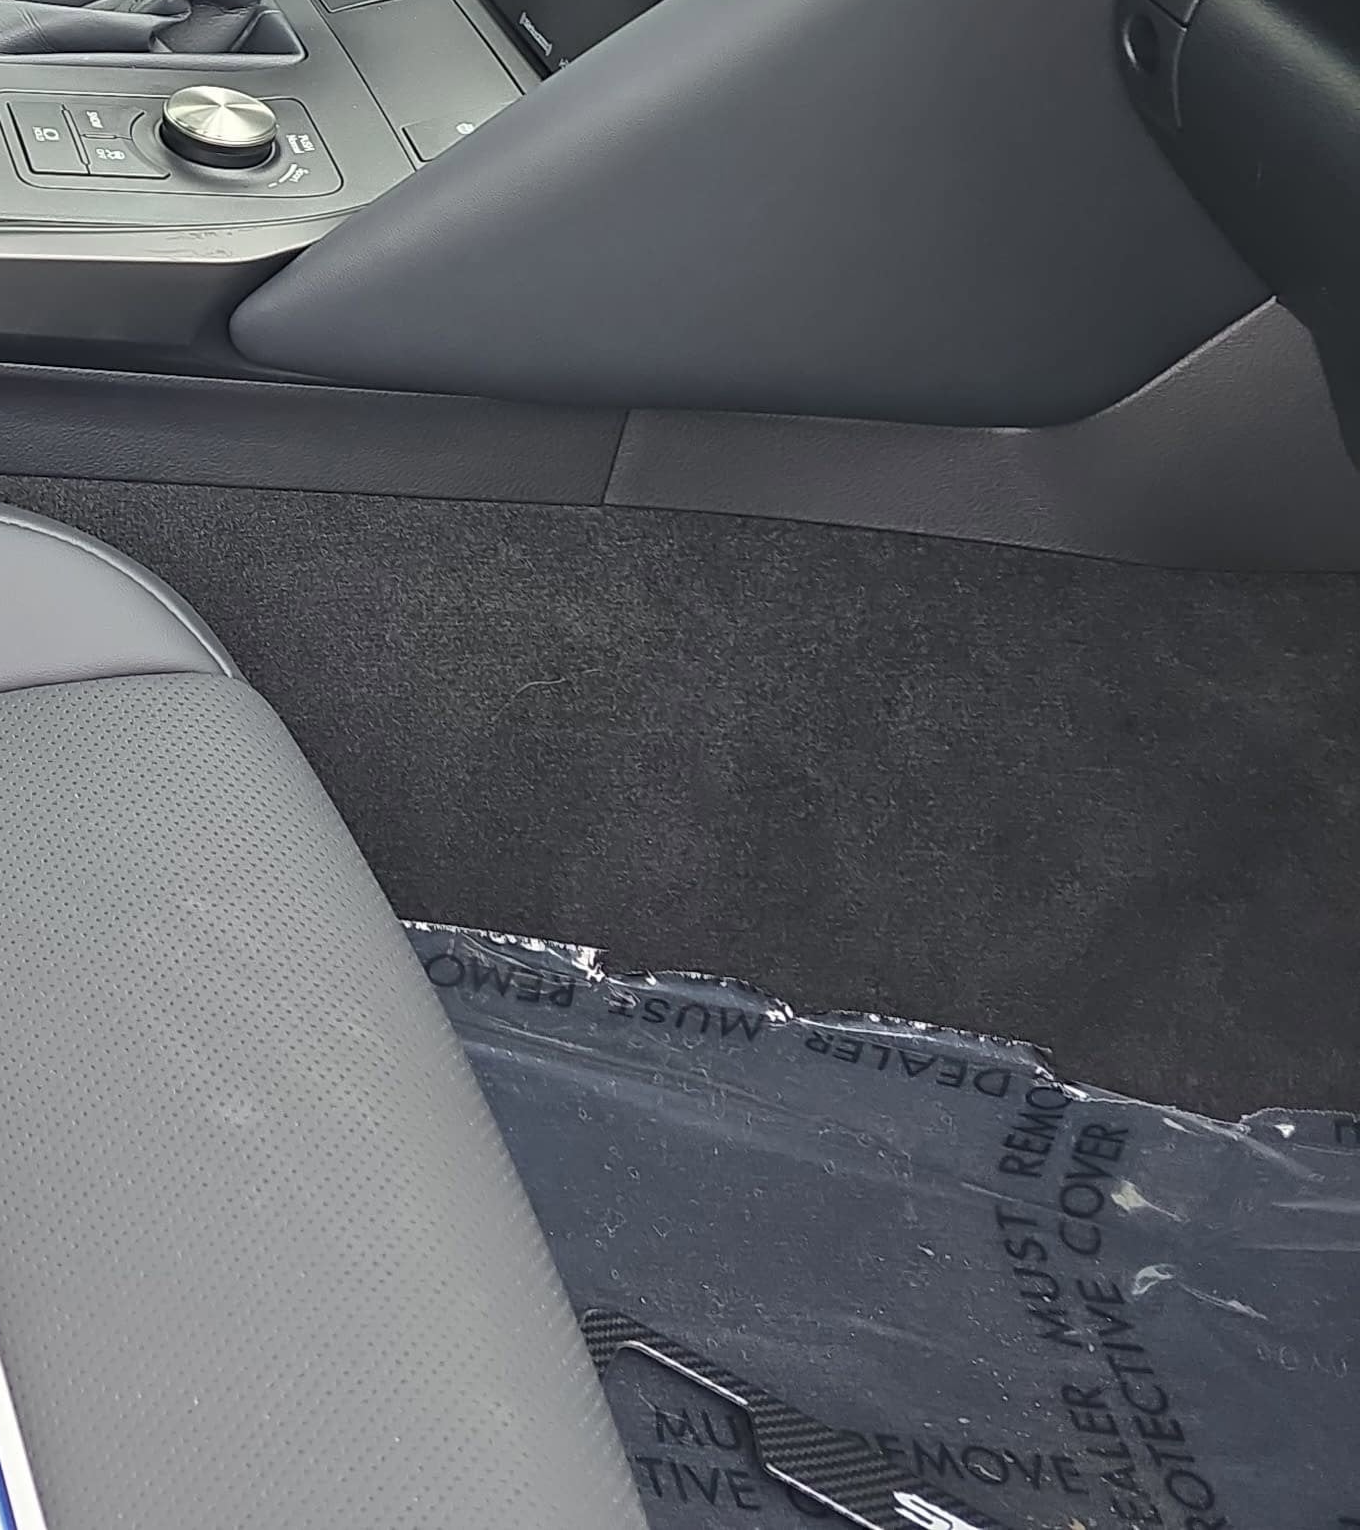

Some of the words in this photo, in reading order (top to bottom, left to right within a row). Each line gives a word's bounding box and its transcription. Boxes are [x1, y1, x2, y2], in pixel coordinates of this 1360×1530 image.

[423, 952, 576, 1009] REMO
[607, 999, 766, 1043] MUST
[803, 1029, 1011, 1099] DEALER
[998, 1082, 1073, 1179] REMO
[1058, 1122, 1130, 1257] COVER
[995, 1205, 1084, 1349] MUST
[655, 1408, 740, 1451] MU
[1078, 1278, 1227, 1530] ROTECTIVE
[632, 1456, 762, 1510] TIVE
[1060, 1383, 1164, 1528] EALER
